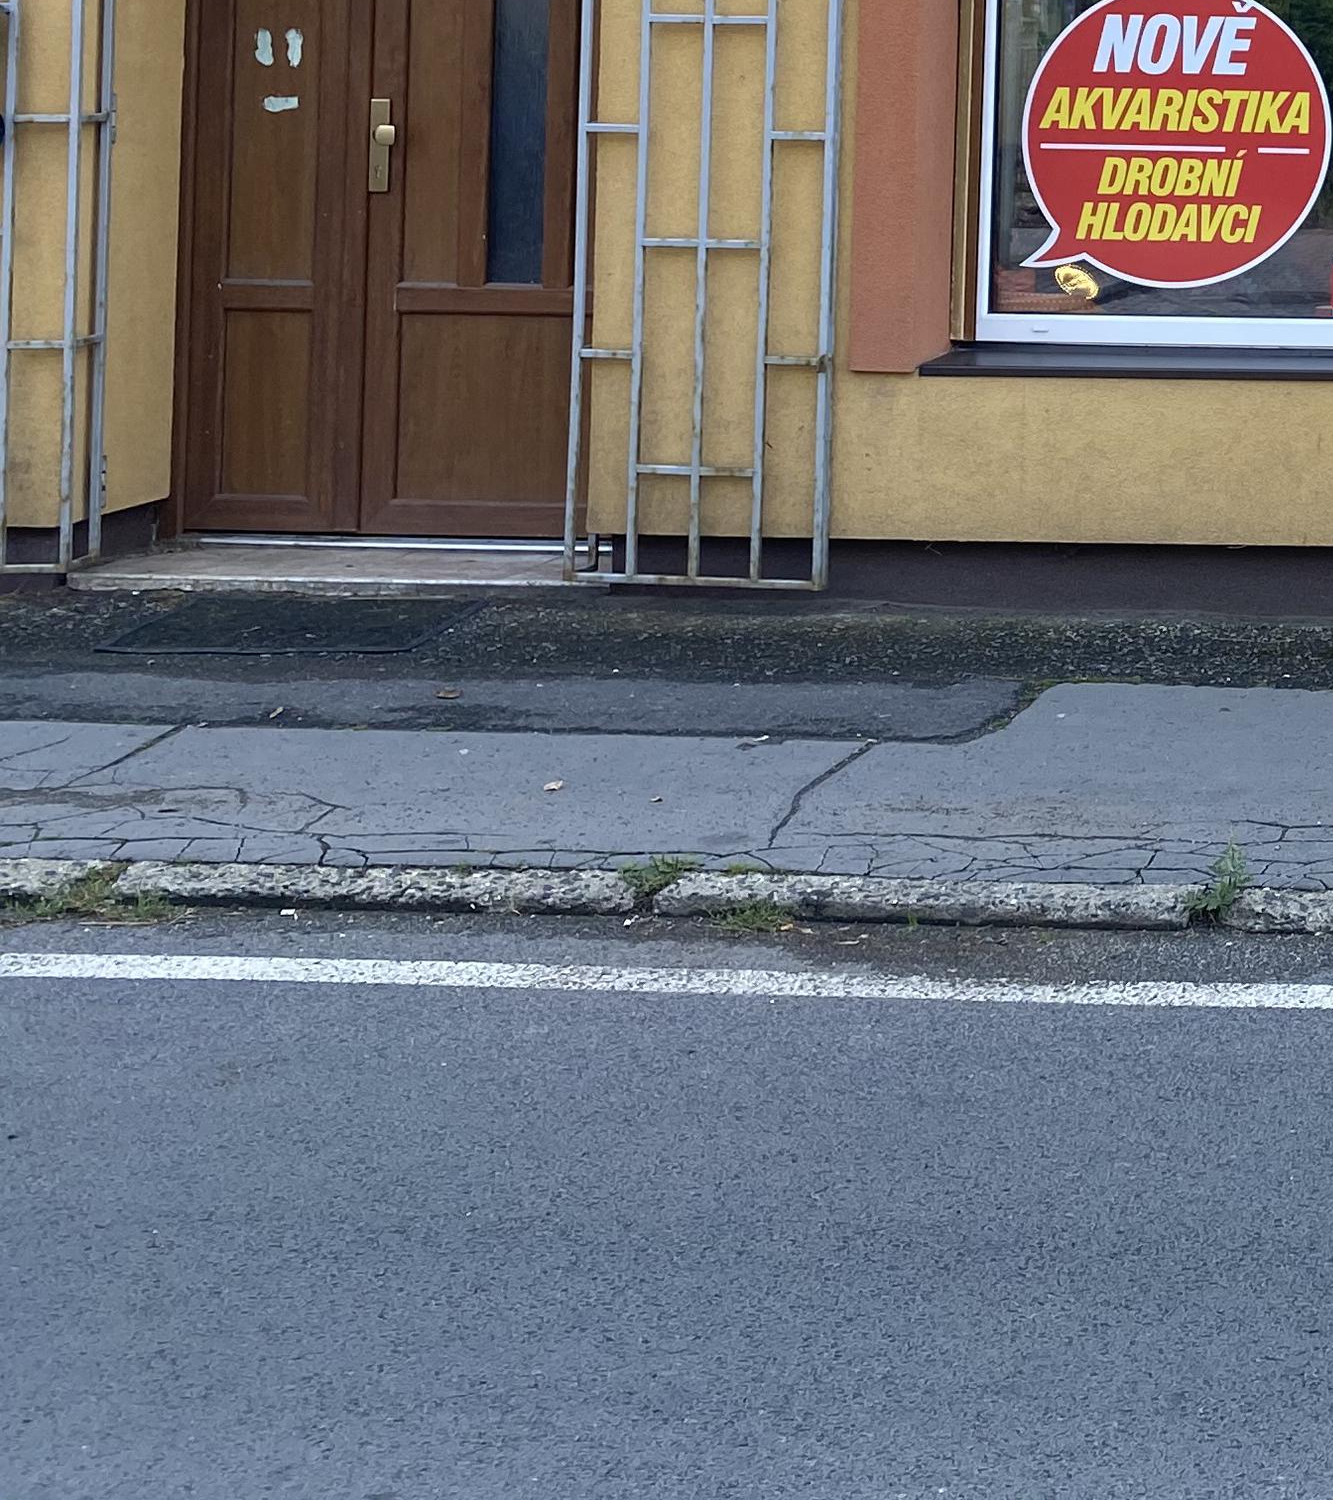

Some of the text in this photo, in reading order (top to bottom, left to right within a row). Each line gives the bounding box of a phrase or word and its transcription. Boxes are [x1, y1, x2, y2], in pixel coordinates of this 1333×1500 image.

[1092, 0, 1257, 76] NOVĚ
[1039, 86, 1311, 135] AKVARISTIKA
[1097, 149, 1247, 197] DROBNÍ
[1075, 201, 1262, 243] HLODAVCI
